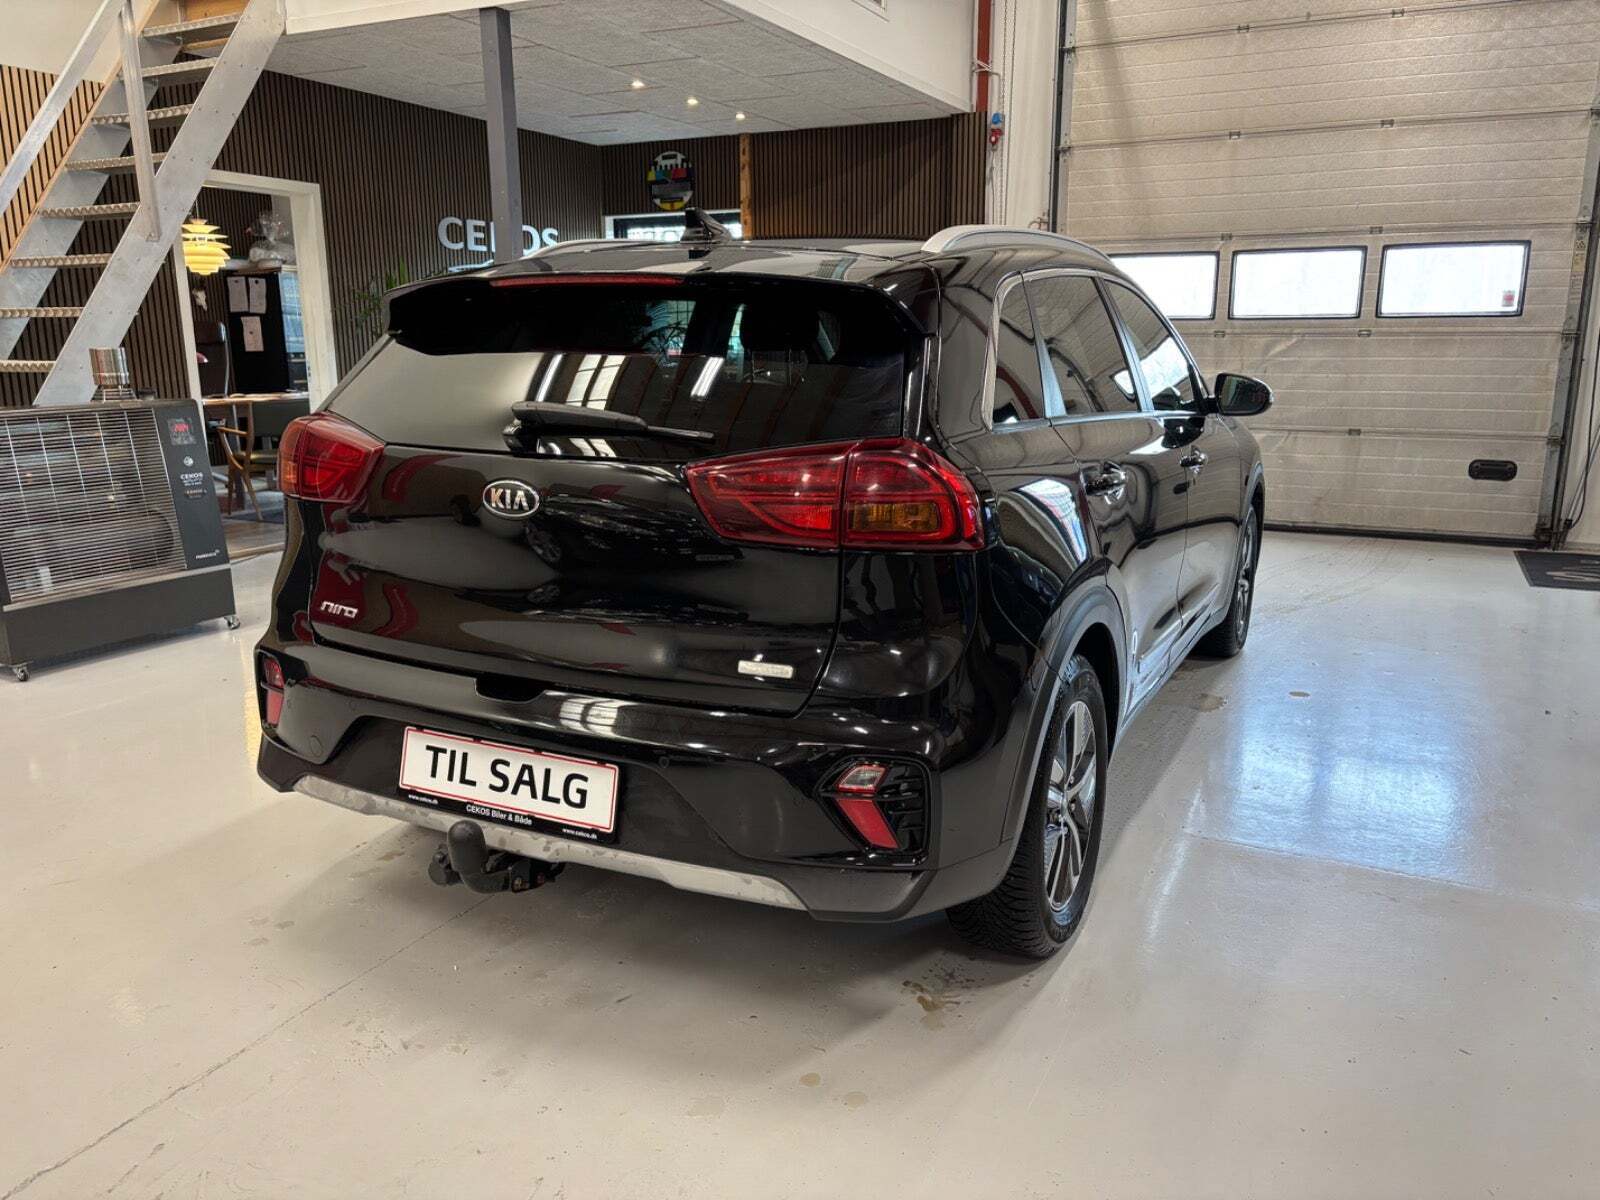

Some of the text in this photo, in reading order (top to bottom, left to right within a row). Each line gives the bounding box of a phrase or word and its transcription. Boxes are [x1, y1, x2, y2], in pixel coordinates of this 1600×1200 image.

[491, 487, 529, 510] KIA
[320, 601, 359, 618] niro
[425, 744, 589, 809] TIL SALG
[466, 804, 490, 816] CEKOS
[508, 813, 513, 821] &
